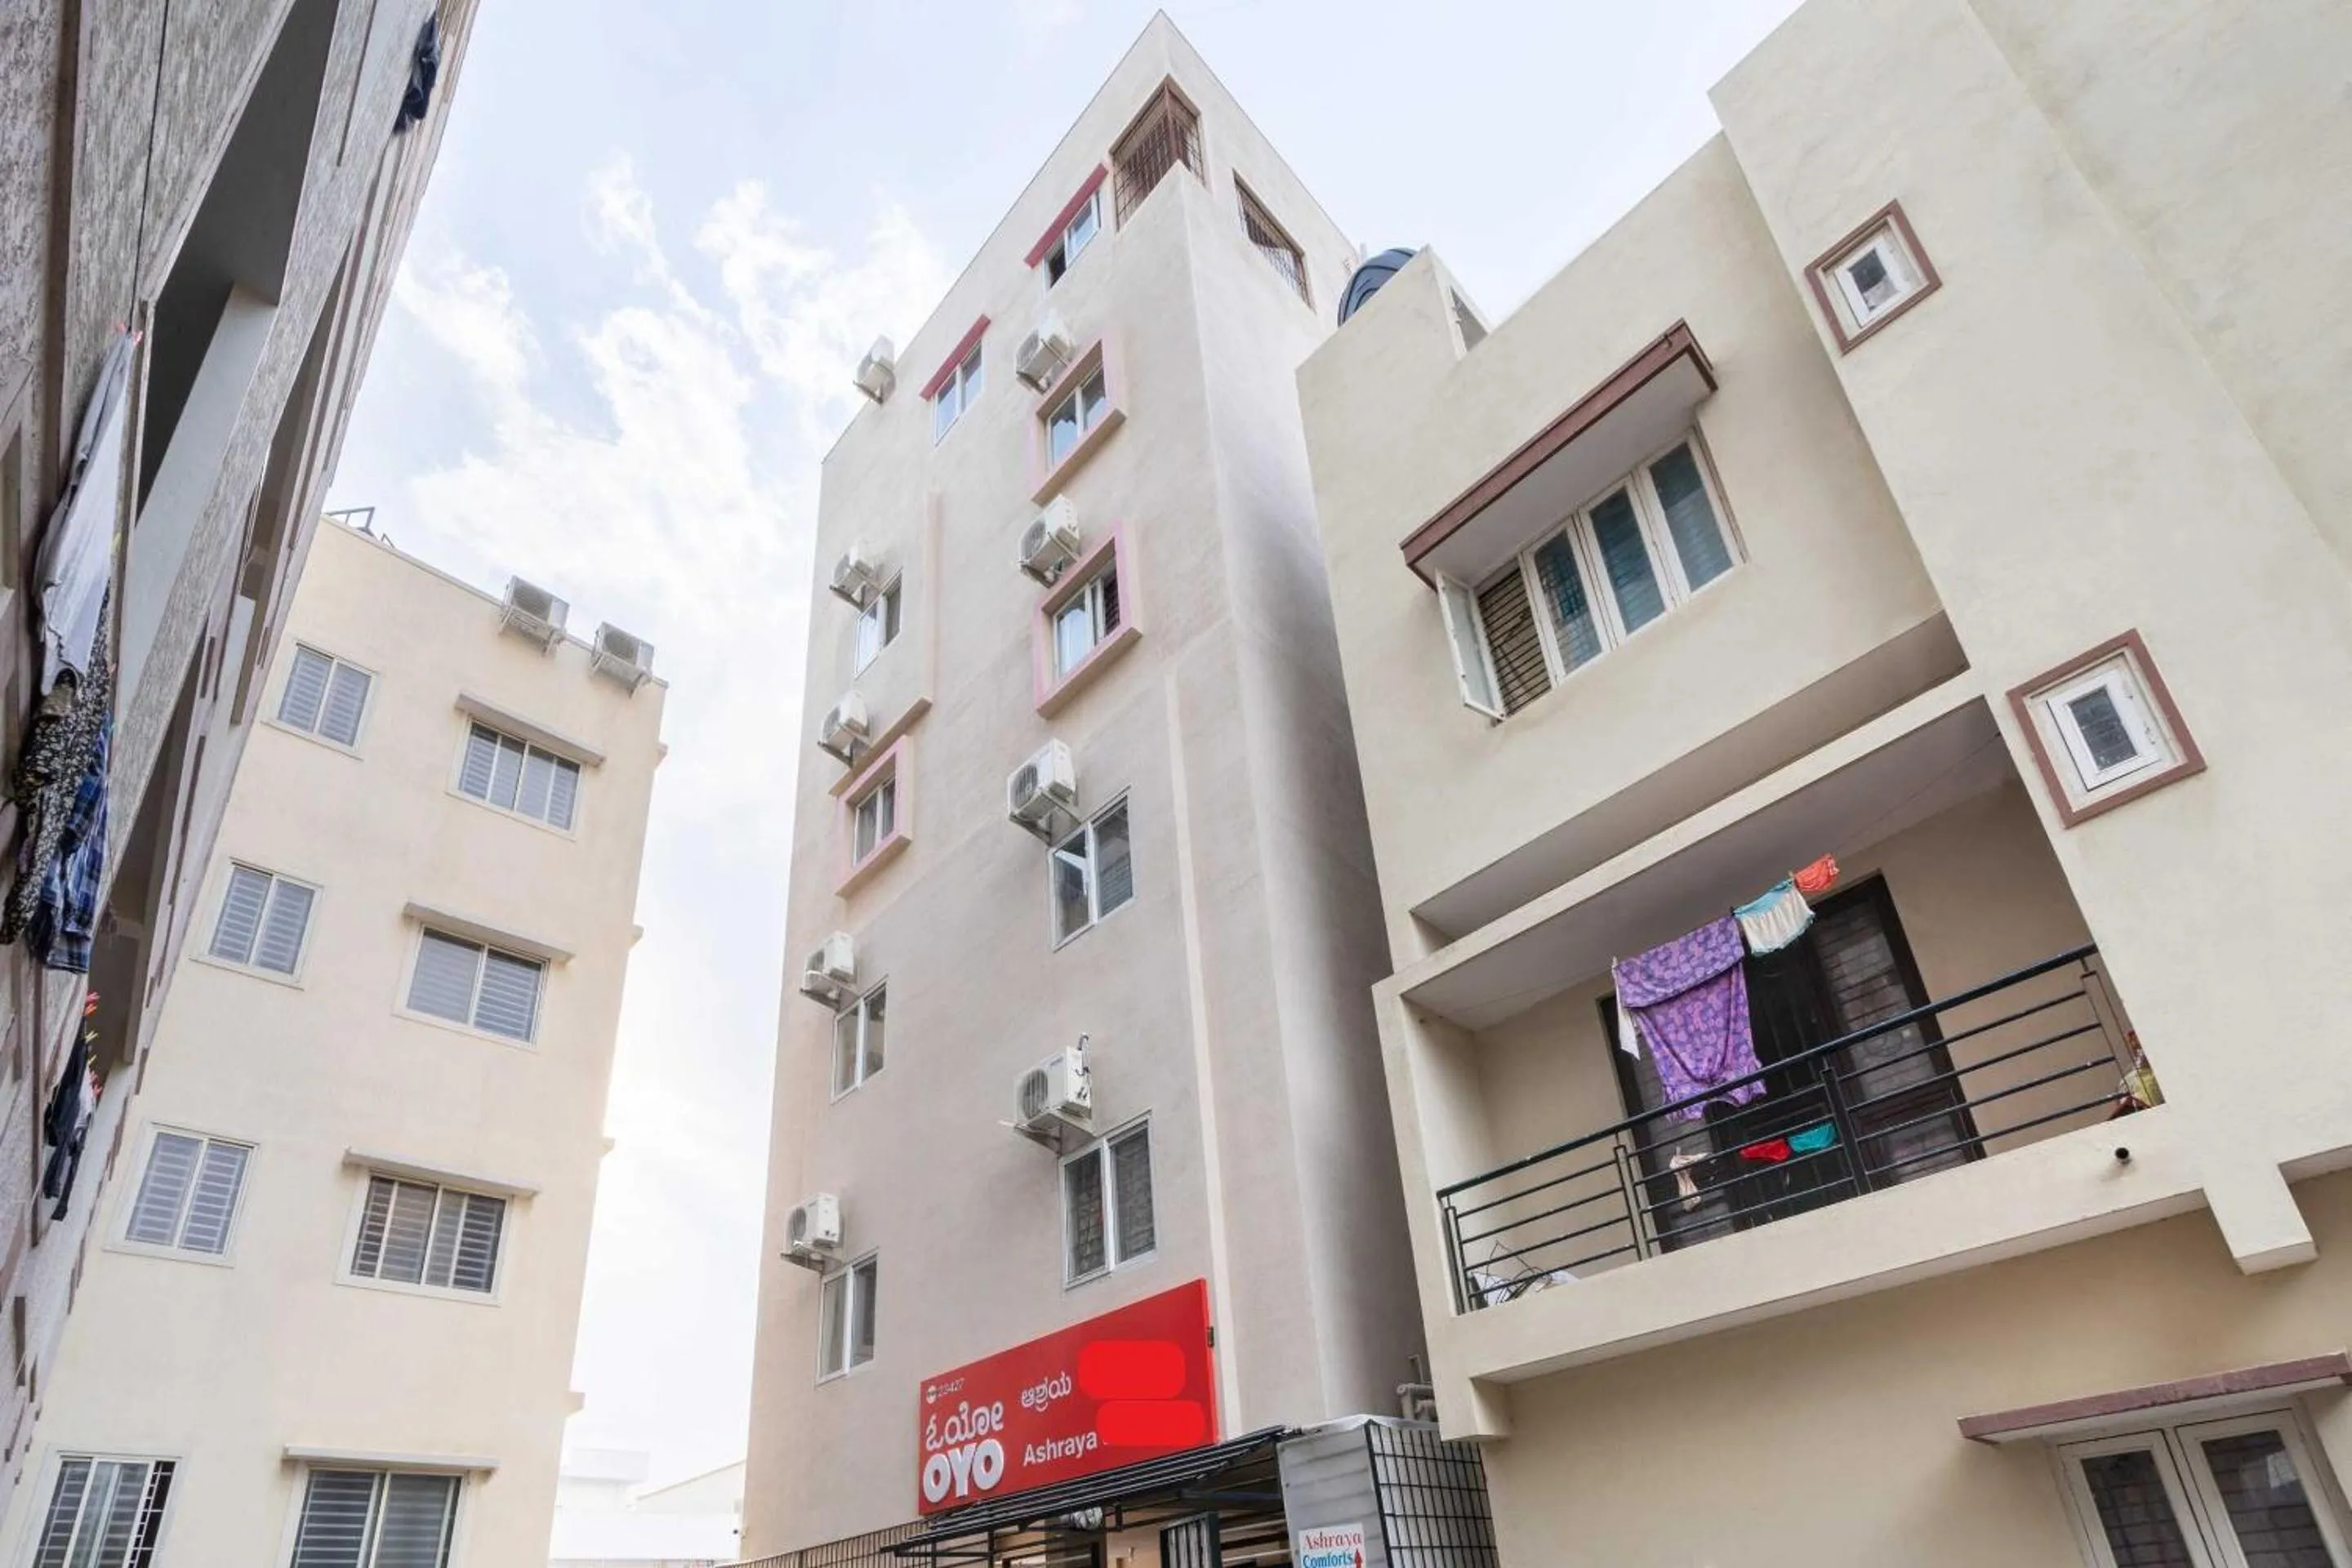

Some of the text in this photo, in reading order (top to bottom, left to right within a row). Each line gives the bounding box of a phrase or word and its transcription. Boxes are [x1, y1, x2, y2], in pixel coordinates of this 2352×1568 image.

[1022, 1431, 1098, 1467] Ashraya
[923, 1438, 1004, 1503] OYO
[1303, 1530, 1361, 1550] Ashraya
[1303, 1551, 1353, 1568] Comforts
